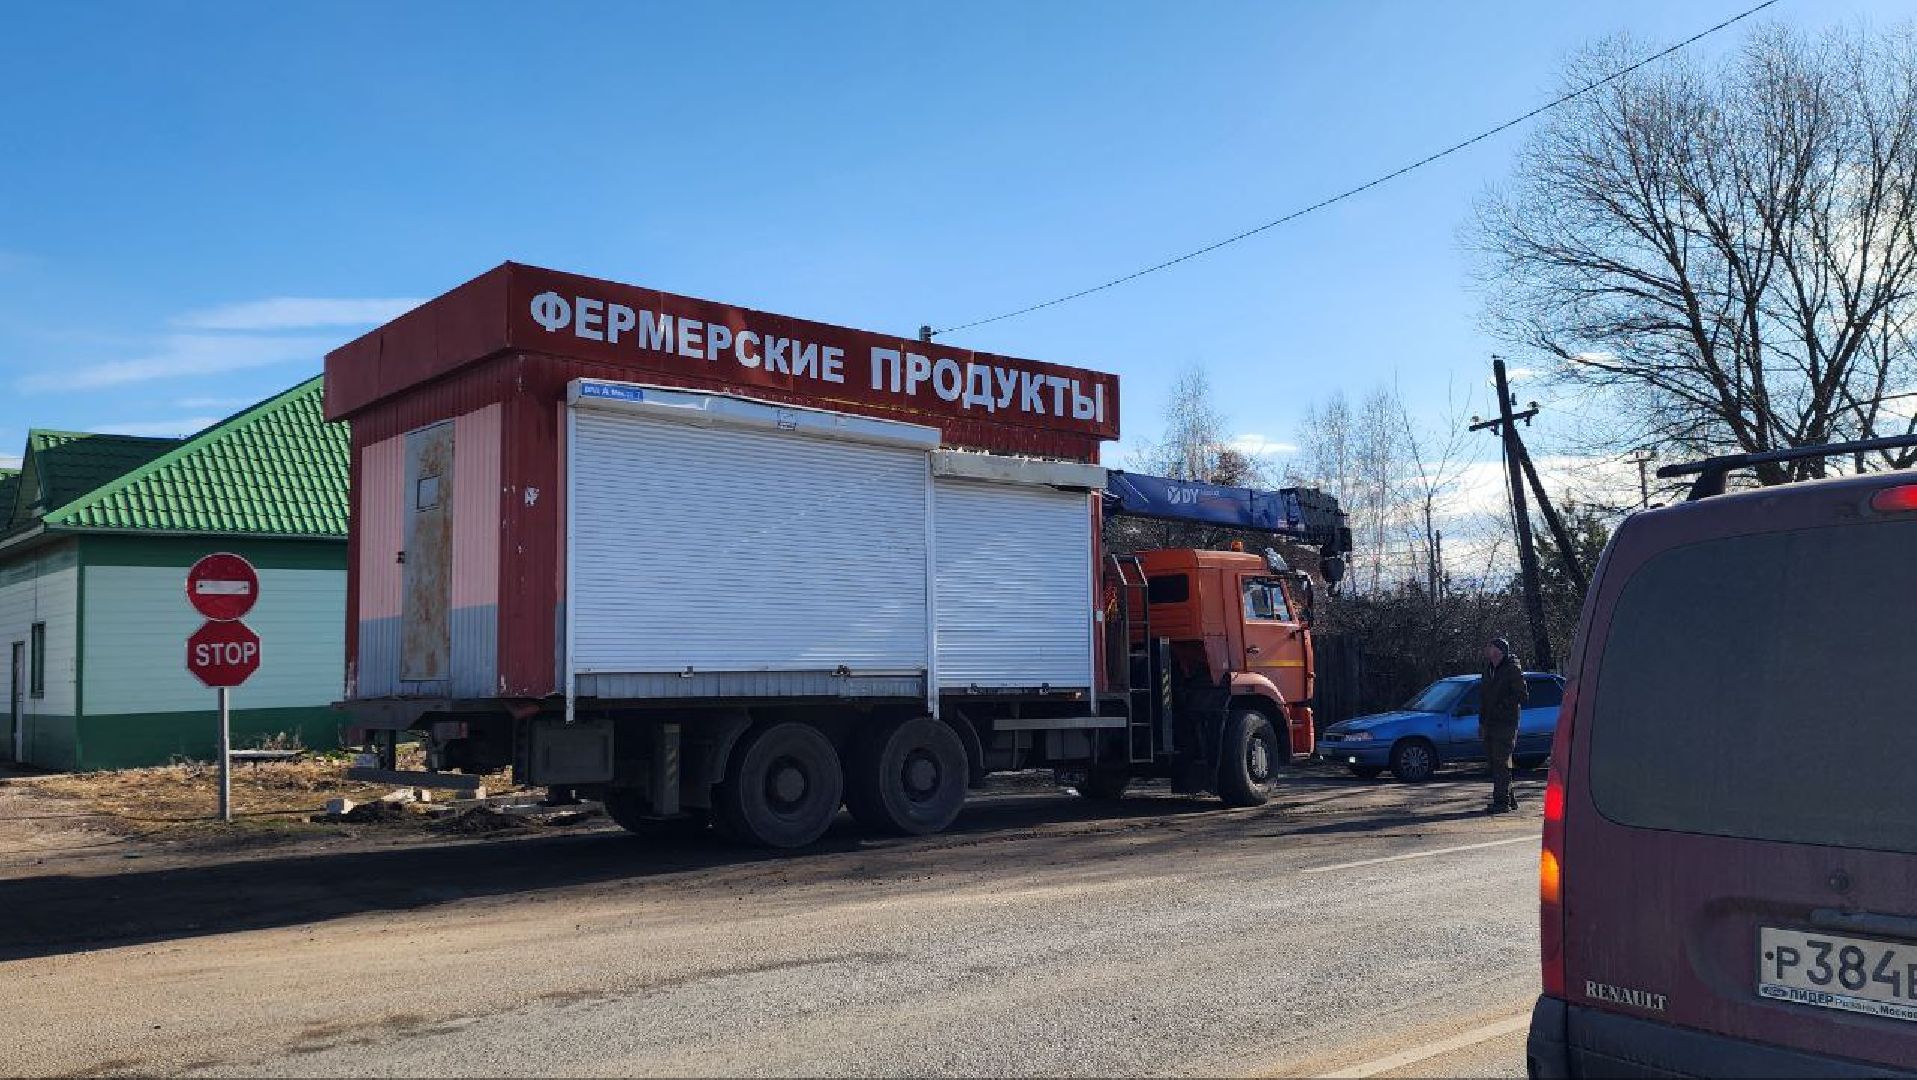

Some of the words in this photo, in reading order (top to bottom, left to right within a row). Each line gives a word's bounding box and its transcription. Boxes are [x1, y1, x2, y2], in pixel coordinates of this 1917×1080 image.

[531, 292, 844, 384] ФЕРМЕРСКИЕ
[870, 347, 1104, 423] ПРОДУКТЫ
[196, 642, 256, 666] STOP
[1585, 981, 1667, 1010] RENAULT
